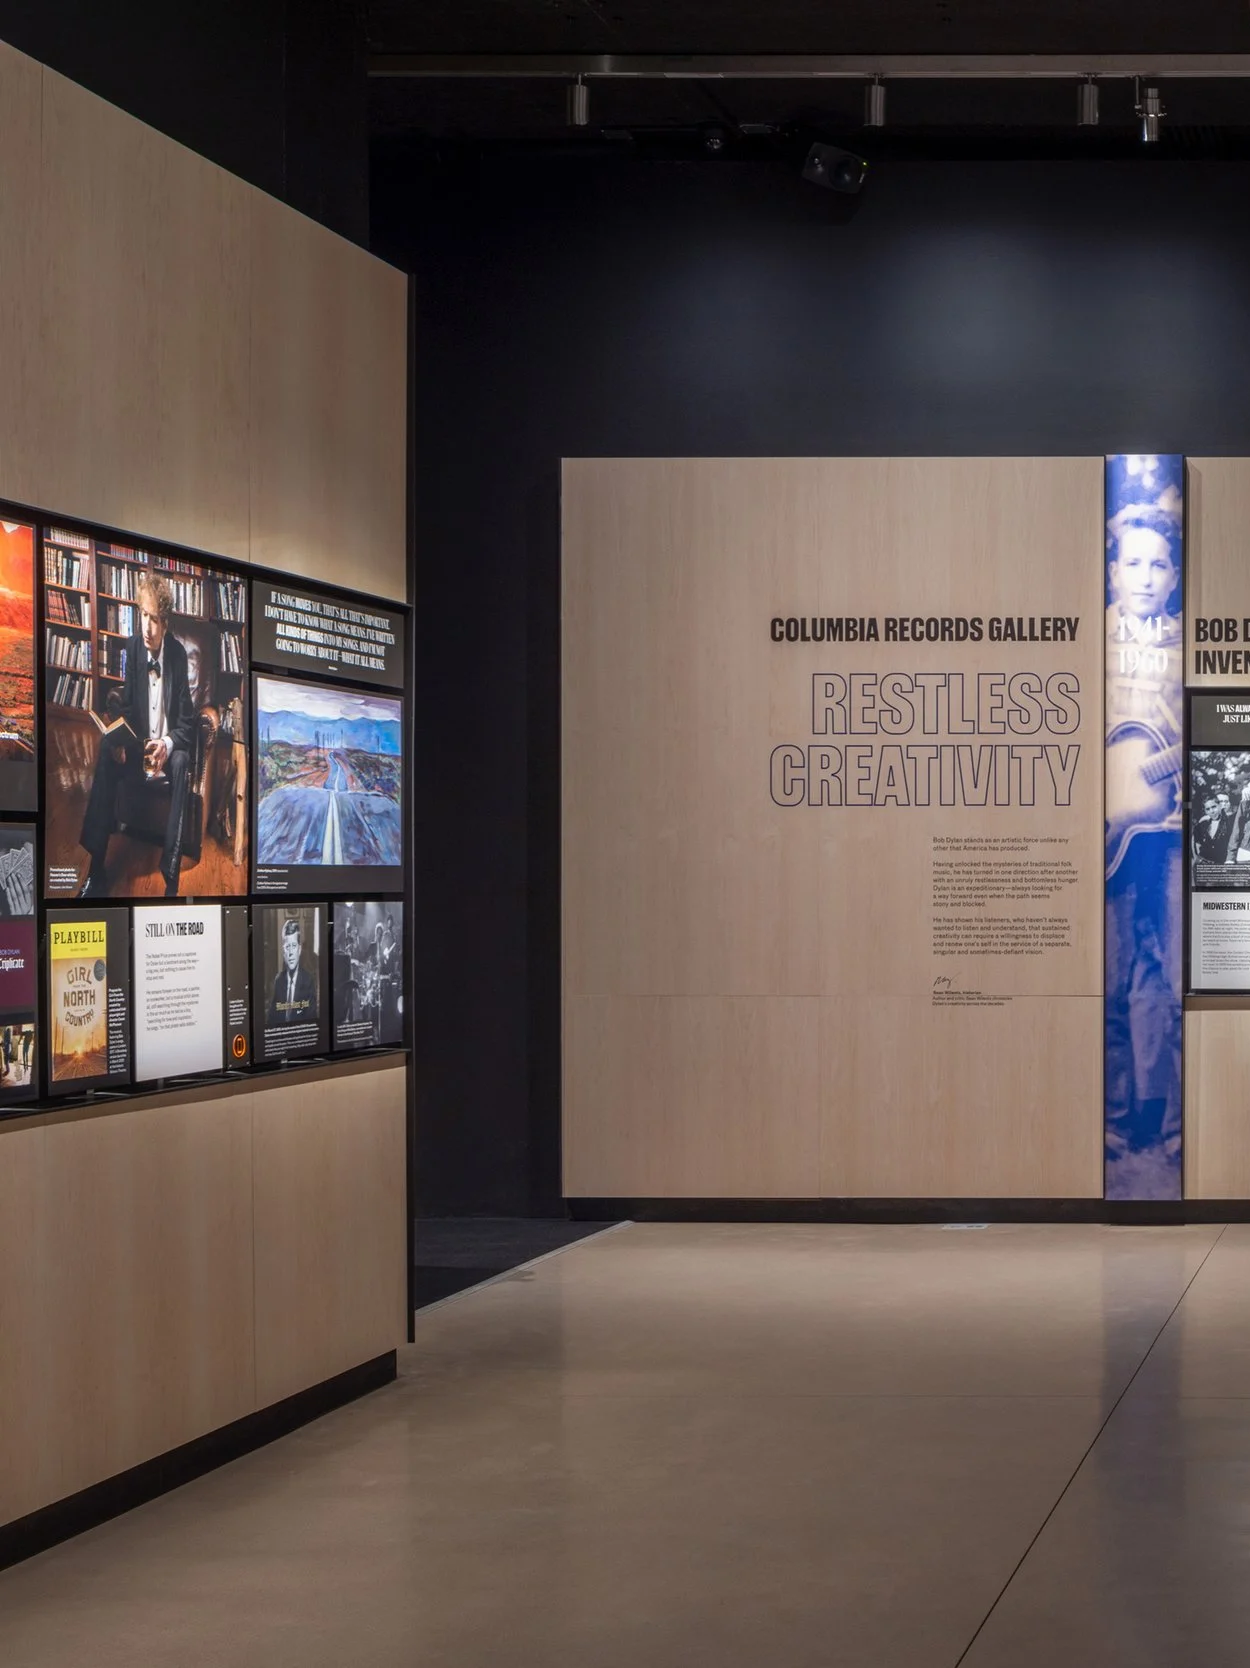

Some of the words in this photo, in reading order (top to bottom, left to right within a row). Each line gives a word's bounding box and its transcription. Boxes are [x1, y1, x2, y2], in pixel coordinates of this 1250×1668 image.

[770, 617, 878, 642] COLUMBIA
[884, 617, 983, 642] RECORDS
[988, 617, 1080, 642] GALLERY
[1195, 618, 1238, 642] BOB
[1118, 648, 1168, 674] 1960
[812, 673, 1080, 734] RESTLESS
[1223, 715, 1240, 723] JUST
[770, 744, 1080, 806] CREATIVITY
[54, 930, 104, 944] PLAYBILL
[146, 922, 164, 938] STILL
[166, 923, 176, 936] ON
[176, 922, 187, 936] THE
[188, 922, 204, 935] ROAD
[67, 966, 92, 984] GIRL
[64, 990, 95, 1007] NORTH
[65, 1009, 94, 1026] COUNTRY
